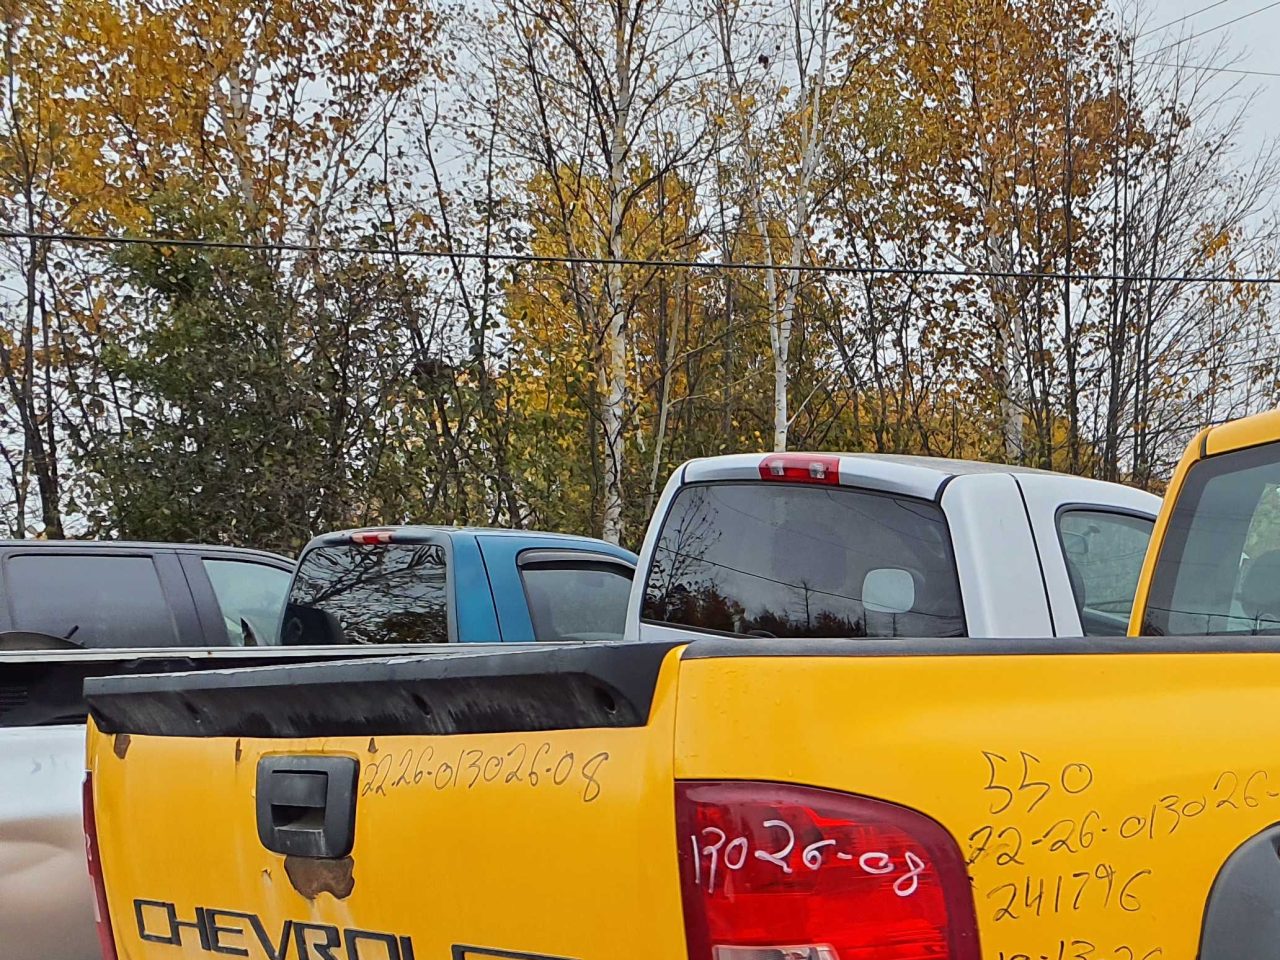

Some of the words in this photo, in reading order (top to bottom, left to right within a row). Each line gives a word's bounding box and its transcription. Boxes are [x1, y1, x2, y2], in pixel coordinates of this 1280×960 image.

[981, 750, 1093, 815] 550
[691, 819, 925, 897] 13026-08
[987, 863, 1152, 922] 241796
